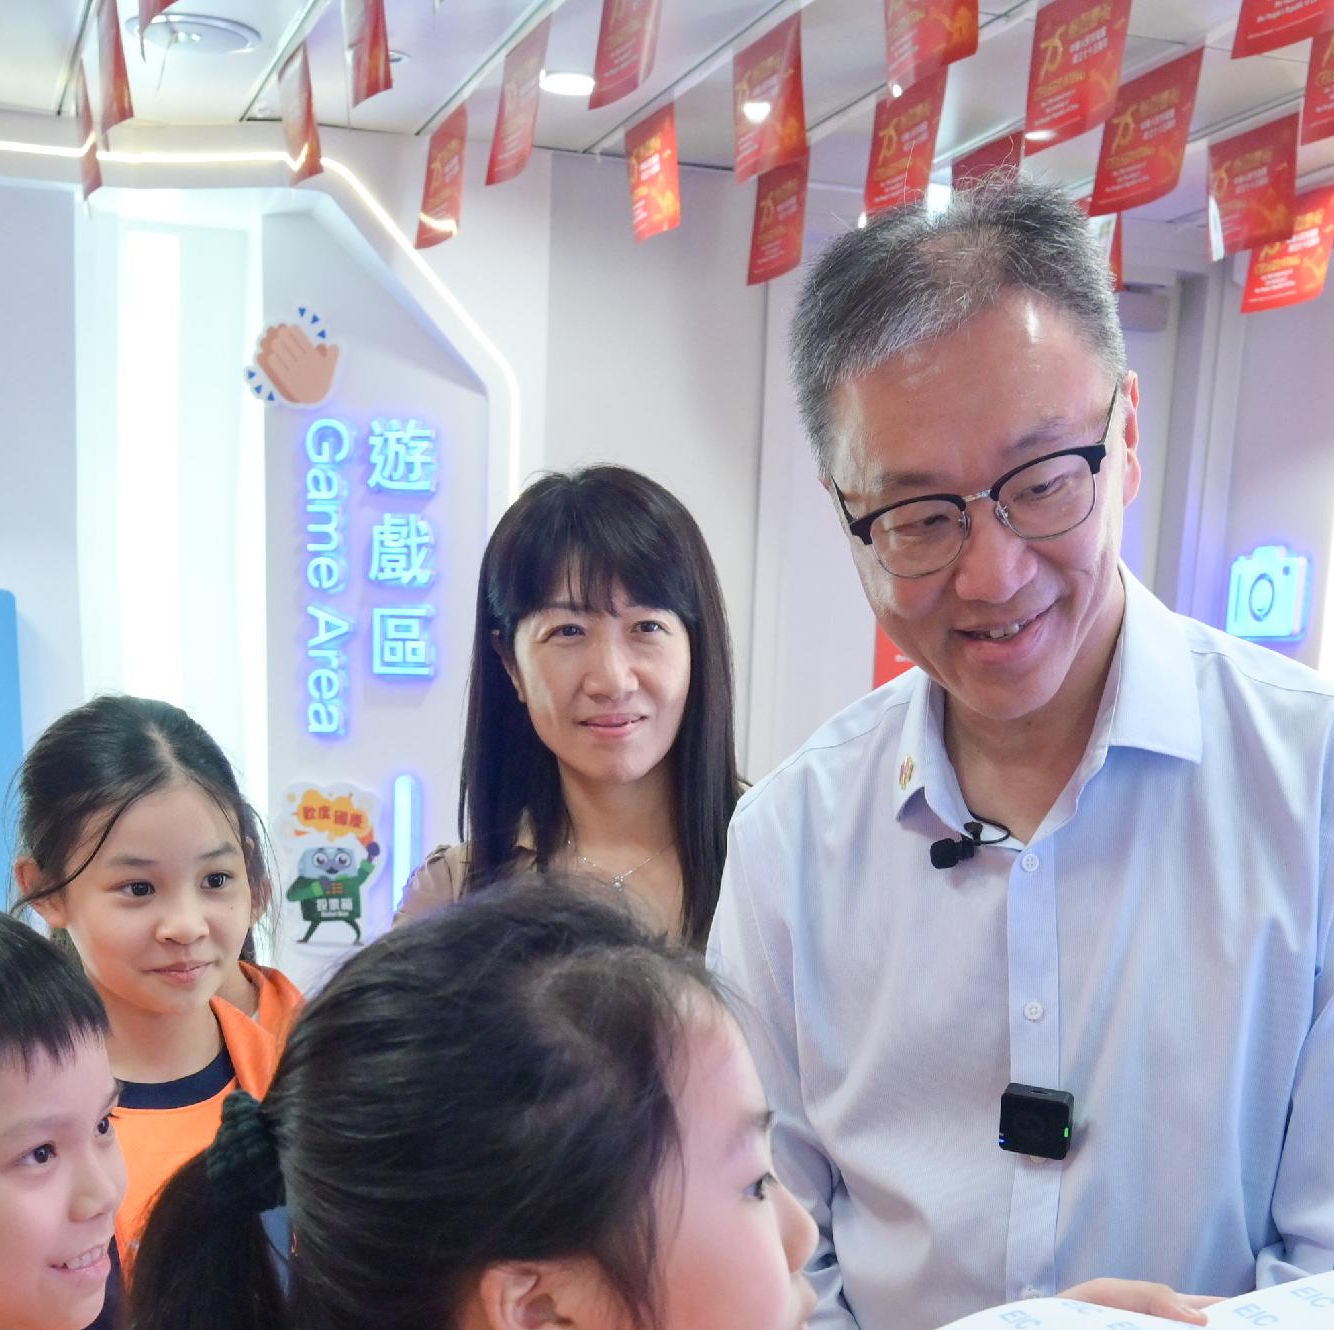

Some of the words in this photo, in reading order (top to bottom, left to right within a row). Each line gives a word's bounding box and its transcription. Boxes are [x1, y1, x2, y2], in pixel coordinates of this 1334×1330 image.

[304, 416, 352, 591] Game
[368, 417, 437, 678] 遊戲區
[306, 604, 352, 736] Area
[999, 1308, 1042, 1330] EIC
[1234, 1303, 1280, 1327] EIC
